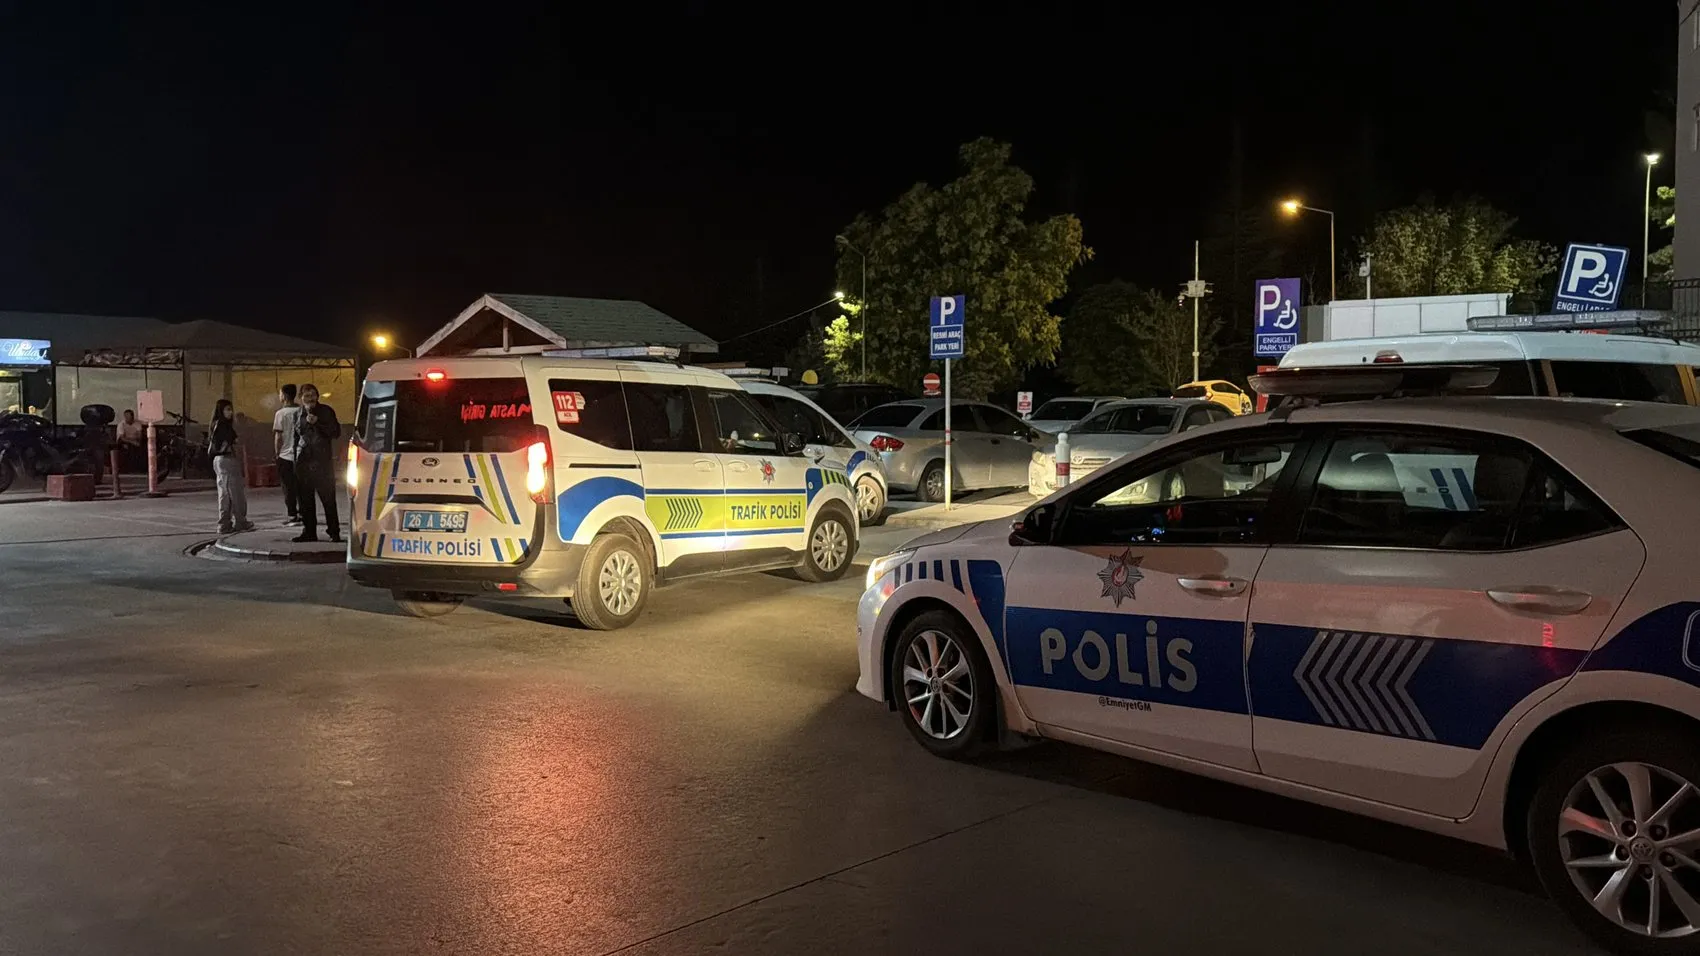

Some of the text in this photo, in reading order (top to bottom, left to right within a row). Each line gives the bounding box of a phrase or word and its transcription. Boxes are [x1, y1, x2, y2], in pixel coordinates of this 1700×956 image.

[1567, 250, 1607, 293] P
[940, 296, 956, 326] P
[1260, 285, 1281, 327] P
[934, 341, 959, 351] PARK YERİ
[1262, 336, 1291, 344] ENGELLİ
[556, 394, 575, 410] 112
[731, 501, 801, 520] TRAFİK POLİSİ
[409, 514, 465, 529] 26 A 5495
[392, 537, 481, 556] TRAFİK POLİSİ
[1040, 620, 1197, 692] POLİS
[1098, 697, 1152, 712] @EmniyetGM
